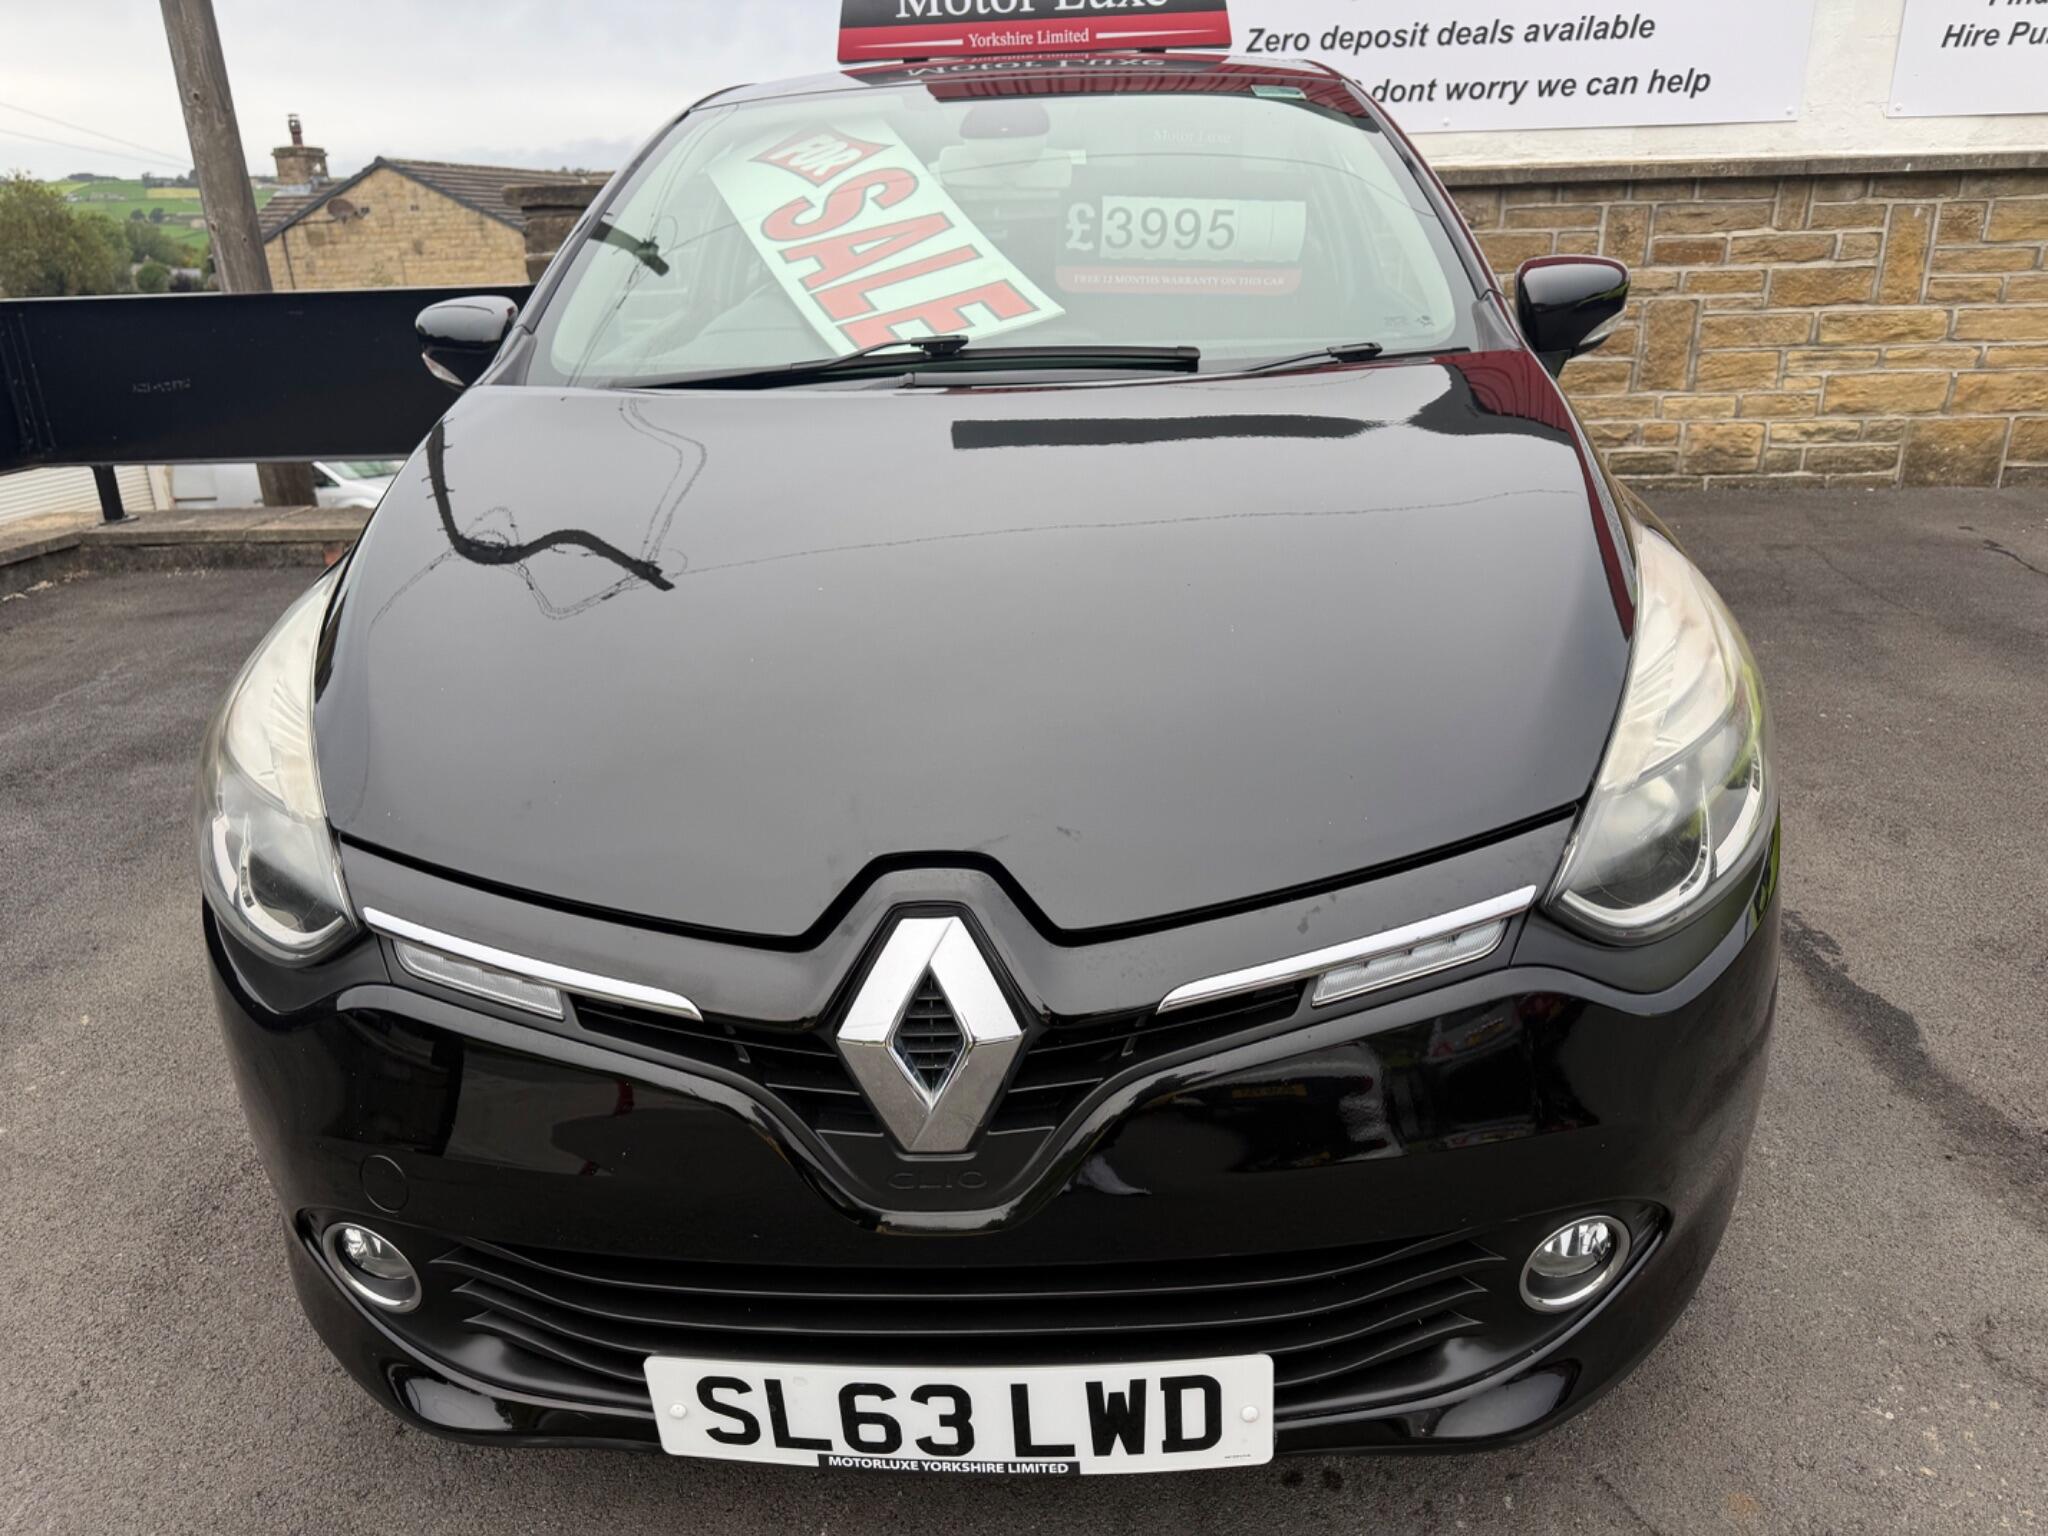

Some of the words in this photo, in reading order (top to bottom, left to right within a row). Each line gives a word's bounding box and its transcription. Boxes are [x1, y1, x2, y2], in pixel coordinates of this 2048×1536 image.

[968, 32, 1033, 48] Yorkshire
[1037, 28, 1089, 45] Limited
[1246, 28, 1311, 53] Zero
[1320, 22, 1429, 56] deposit
[1437, 19, 1515, 46] deals
[1524, 13, 1656, 43] available
[1941, 23, 2000, 48] Hire
[2008, 21, 2048, 46] Pu
[1371, 78, 1438, 103] dont
[1446, 79, 1529, 106] worry
[1538, 77, 1577, 98] we
[1586, 75, 1639, 96] can
[1647, 68, 1711, 99] help
[768, 133, 862, 176] FOR
[1065, 202, 1235, 251] £3995
[760, 167, 1040, 352] SALE
[1161, 275, 1217, 287] WARRANTY
[696, 1375, 975, 1458] SL63
[1010, 1374, 1222, 1458] LWD
[829, 1456, 919, 1472] MOTORLUXE
[921, 1460, 1005, 1474] YORKSHIRE
[1008, 1462, 1069, 1475] LIMITED
